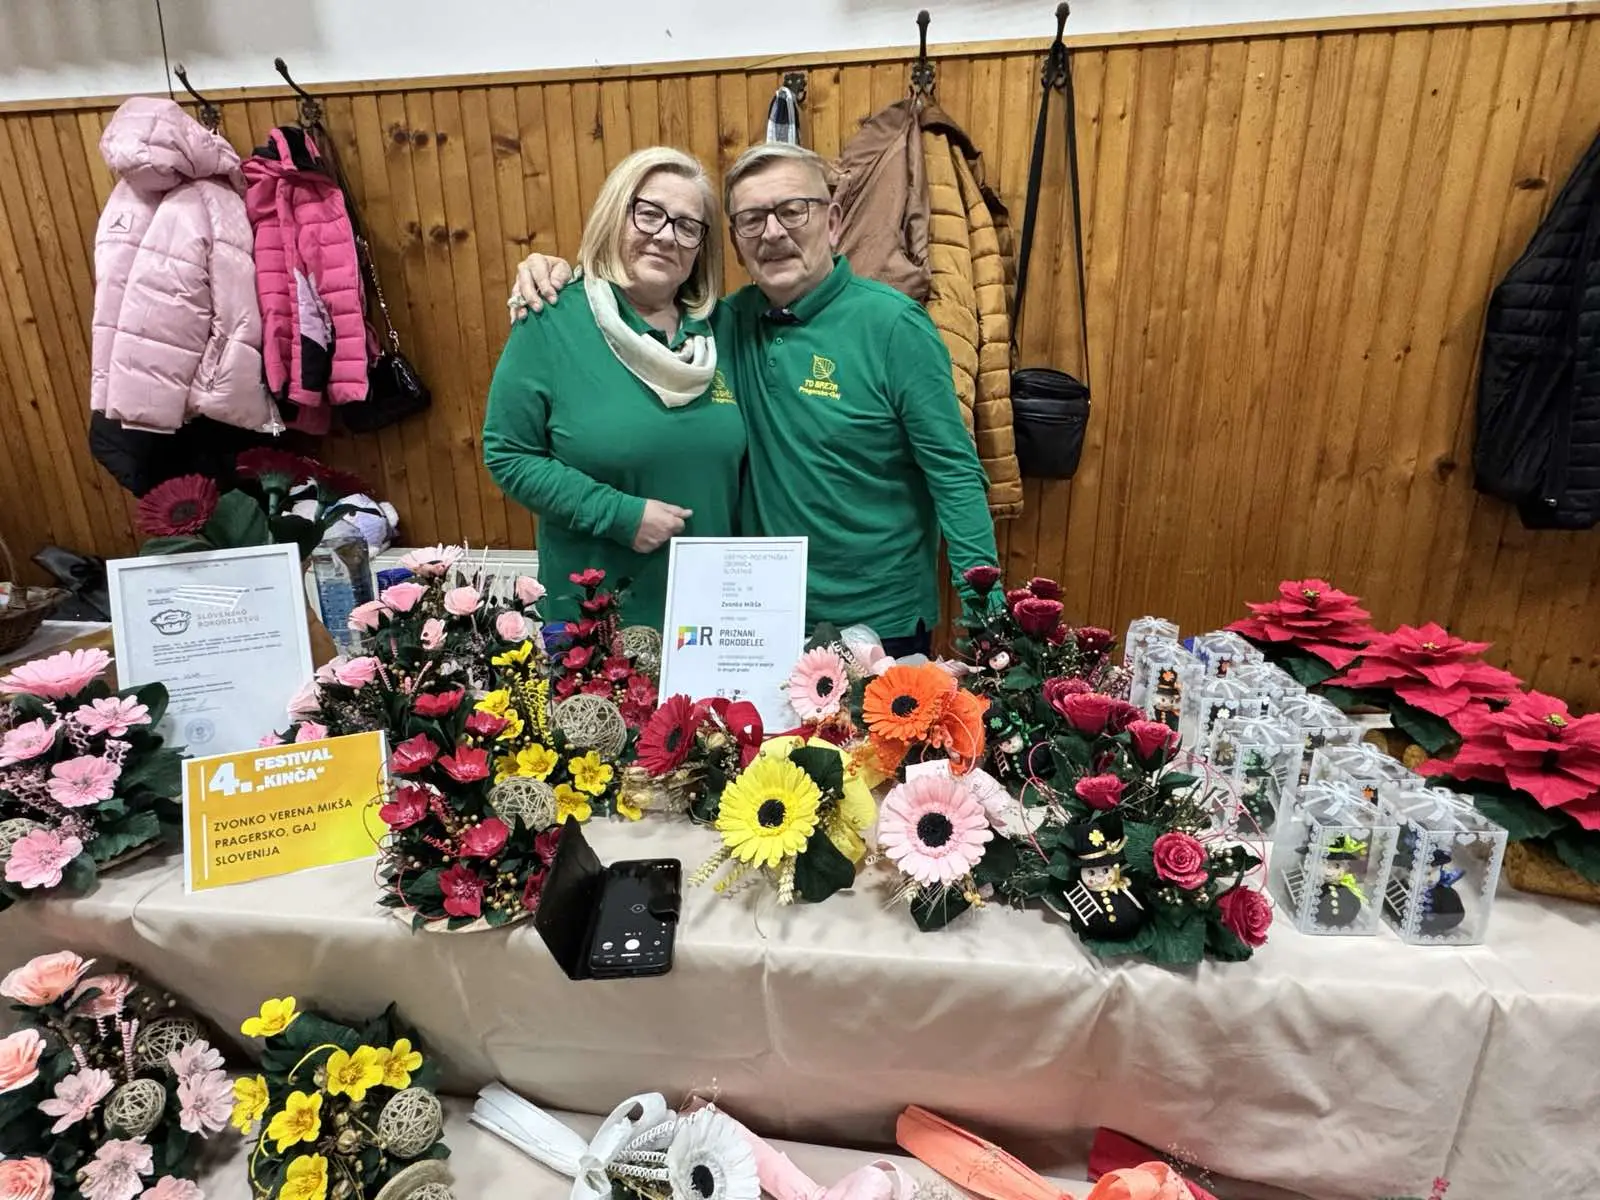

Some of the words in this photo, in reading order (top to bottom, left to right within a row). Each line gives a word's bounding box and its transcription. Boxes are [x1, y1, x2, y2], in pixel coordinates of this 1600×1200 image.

[719, 629, 756, 638] PRIZNANI
[719, 638, 765, 647] ROKODELEC
[208, 762, 253, 797] 4.
[254, 747, 333, 772] FESTIVAL
[213, 814, 266, 832] ZVONKO
[270, 806, 315, 822] VERENA
[317, 798, 353, 813] MIKŠA
[292, 822, 318, 834] GAJ
[215, 846, 281, 866] SLOVENIJA
